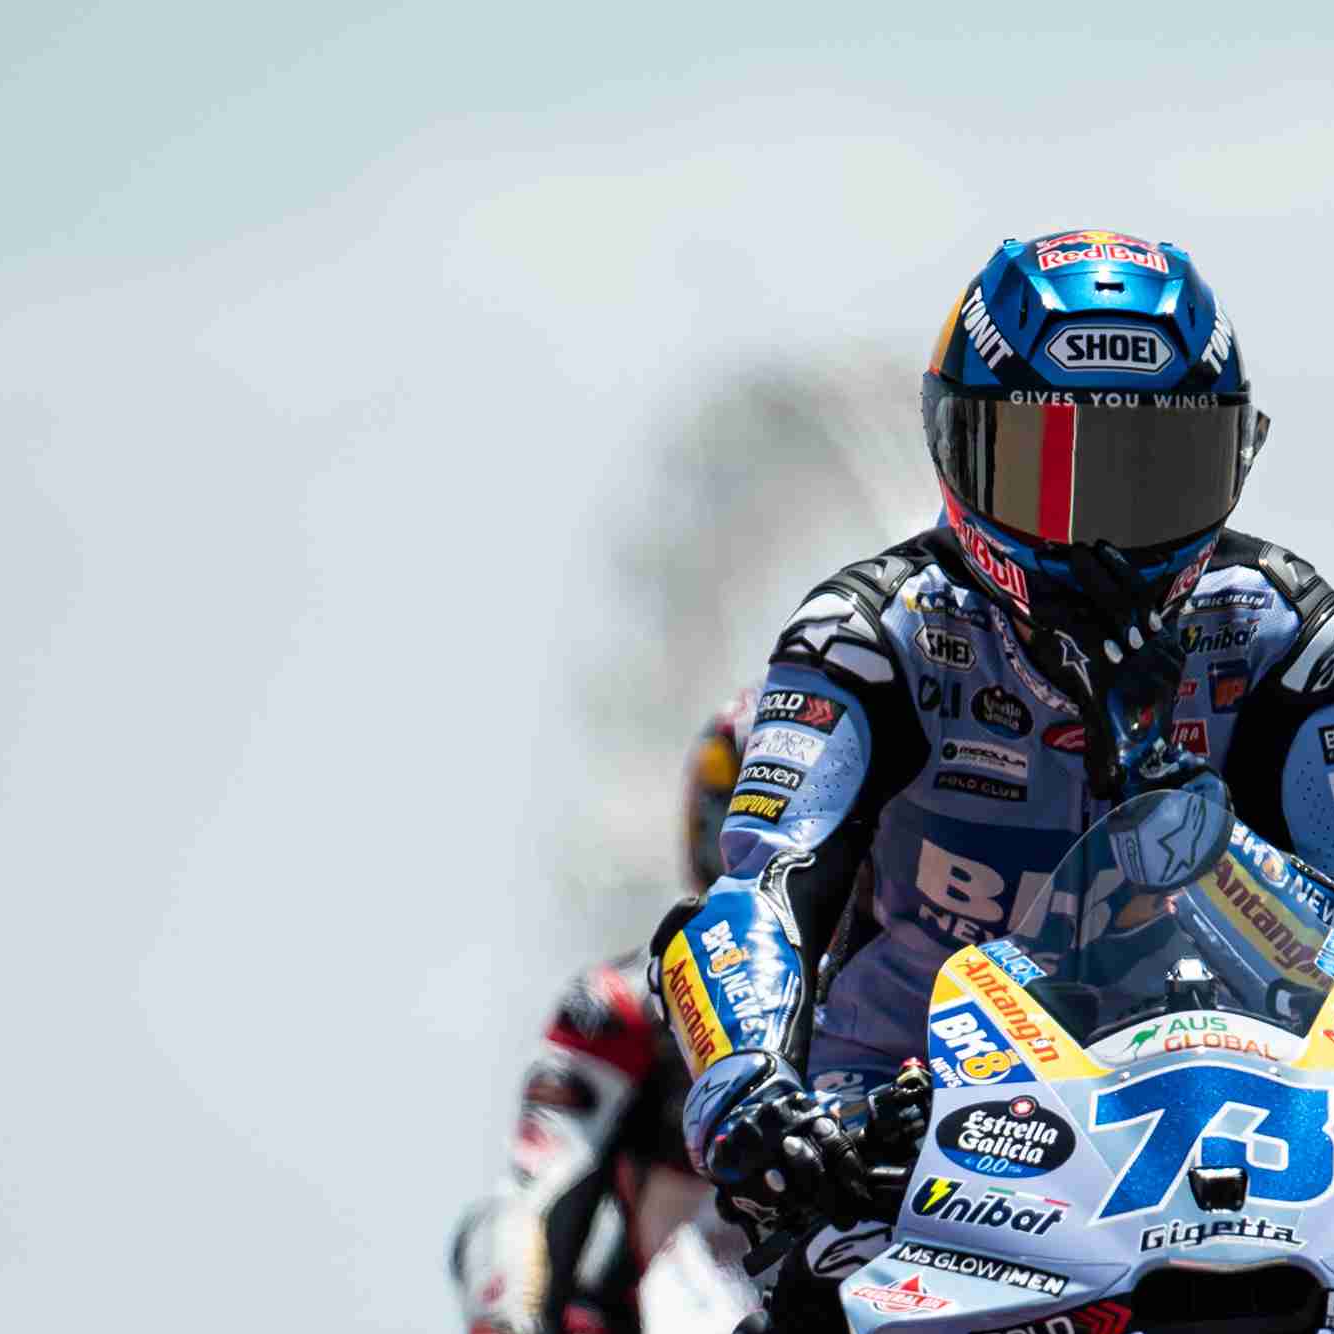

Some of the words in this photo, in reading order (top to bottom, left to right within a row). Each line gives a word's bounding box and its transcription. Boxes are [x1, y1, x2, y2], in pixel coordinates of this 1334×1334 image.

[1038, 244, 1103, 272] Red
[1106, 244, 1169, 273] Bull
[1065, 333, 1157, 365] SHOEI
[1009, 390, 1075, 407] GIVES
[1090, 392, 1140, 408] YOU
[1153, 393, 1219, 409] WINGS
[720, 971, 768, 1033] NEWS
[957, 957, 1060, 1063] Antangin
[1167, 1015, 1229, 1035] AUS
[931, 1012, 1013, 1084] BK8
[1163, 1031, 1280, 1062] GLOBAL
[930, 1056, 964, 1088] NEWS
[962, 1109, 1059, 1145] Estrella
[957, 1128, 1045, 1165] Galicia
[912, 1177, 1063, 1236] Unibat
[1139, 1217, 1303, 1253] Gigetta
[898, 1244, 935, 1265] MS
[934, 1252, 1003, 1279] GLOW
